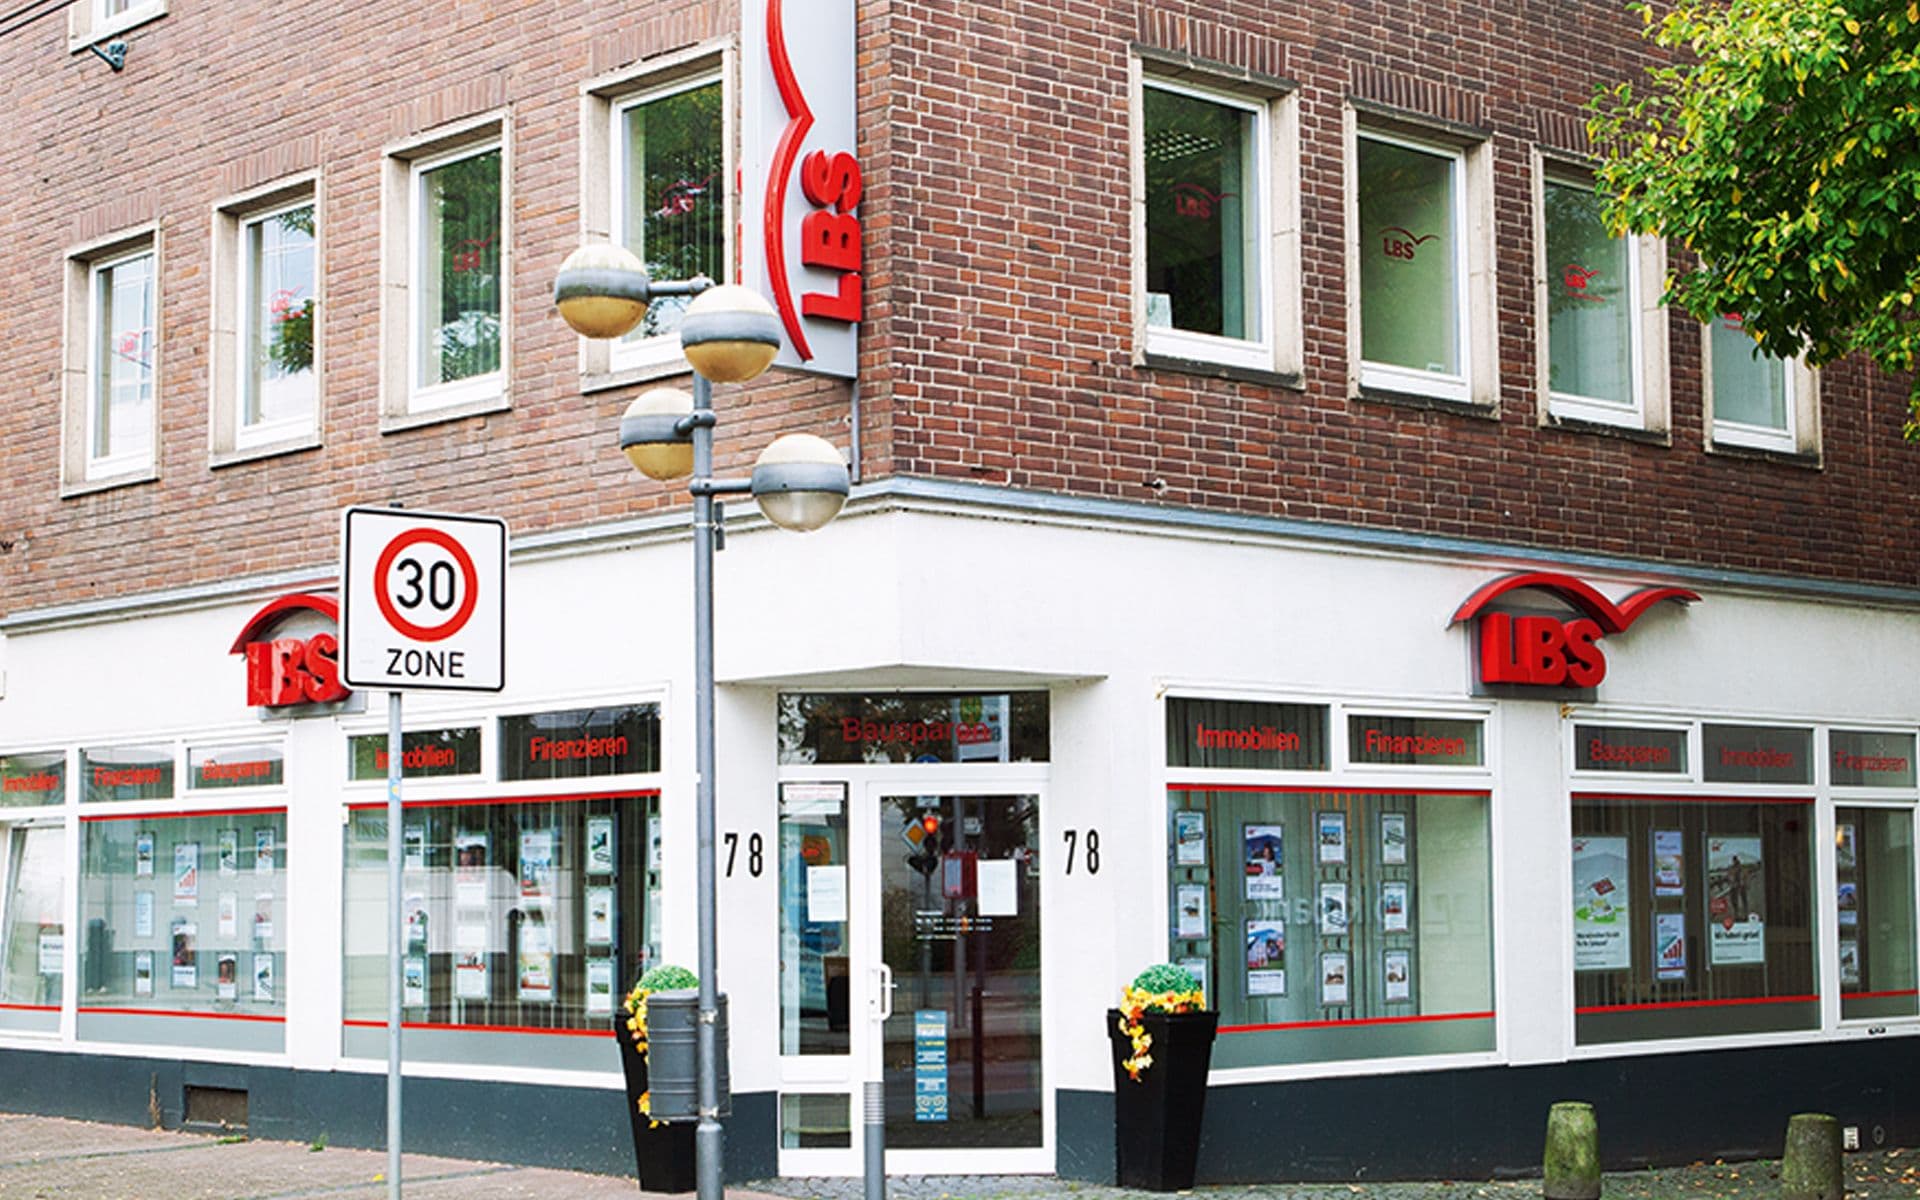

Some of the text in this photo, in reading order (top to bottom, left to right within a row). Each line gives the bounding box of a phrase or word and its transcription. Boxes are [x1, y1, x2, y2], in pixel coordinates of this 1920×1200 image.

[1175, 195, 1211, 219] LBS
[801, 149, 862, 322] LBS
[1383, 238, 1415, 260] LBS
[396, 558, 455, 611] 30
[386, 648, 464, 678] ZONE
[1480, 613, 1606, 688] LBS
[245, 632, 352, 707] LBS
[842, 718, 992, 746] Bausparen
[1197, 723, 1300, 751] Immobilien
[1365, 729, 1466, 756] Finanzieren
[530, 734, 628, 762] Finanzieren
[1590, 739, 1671, 766] Bausparen
[1720, 746, 1796, 768] Immobilien
